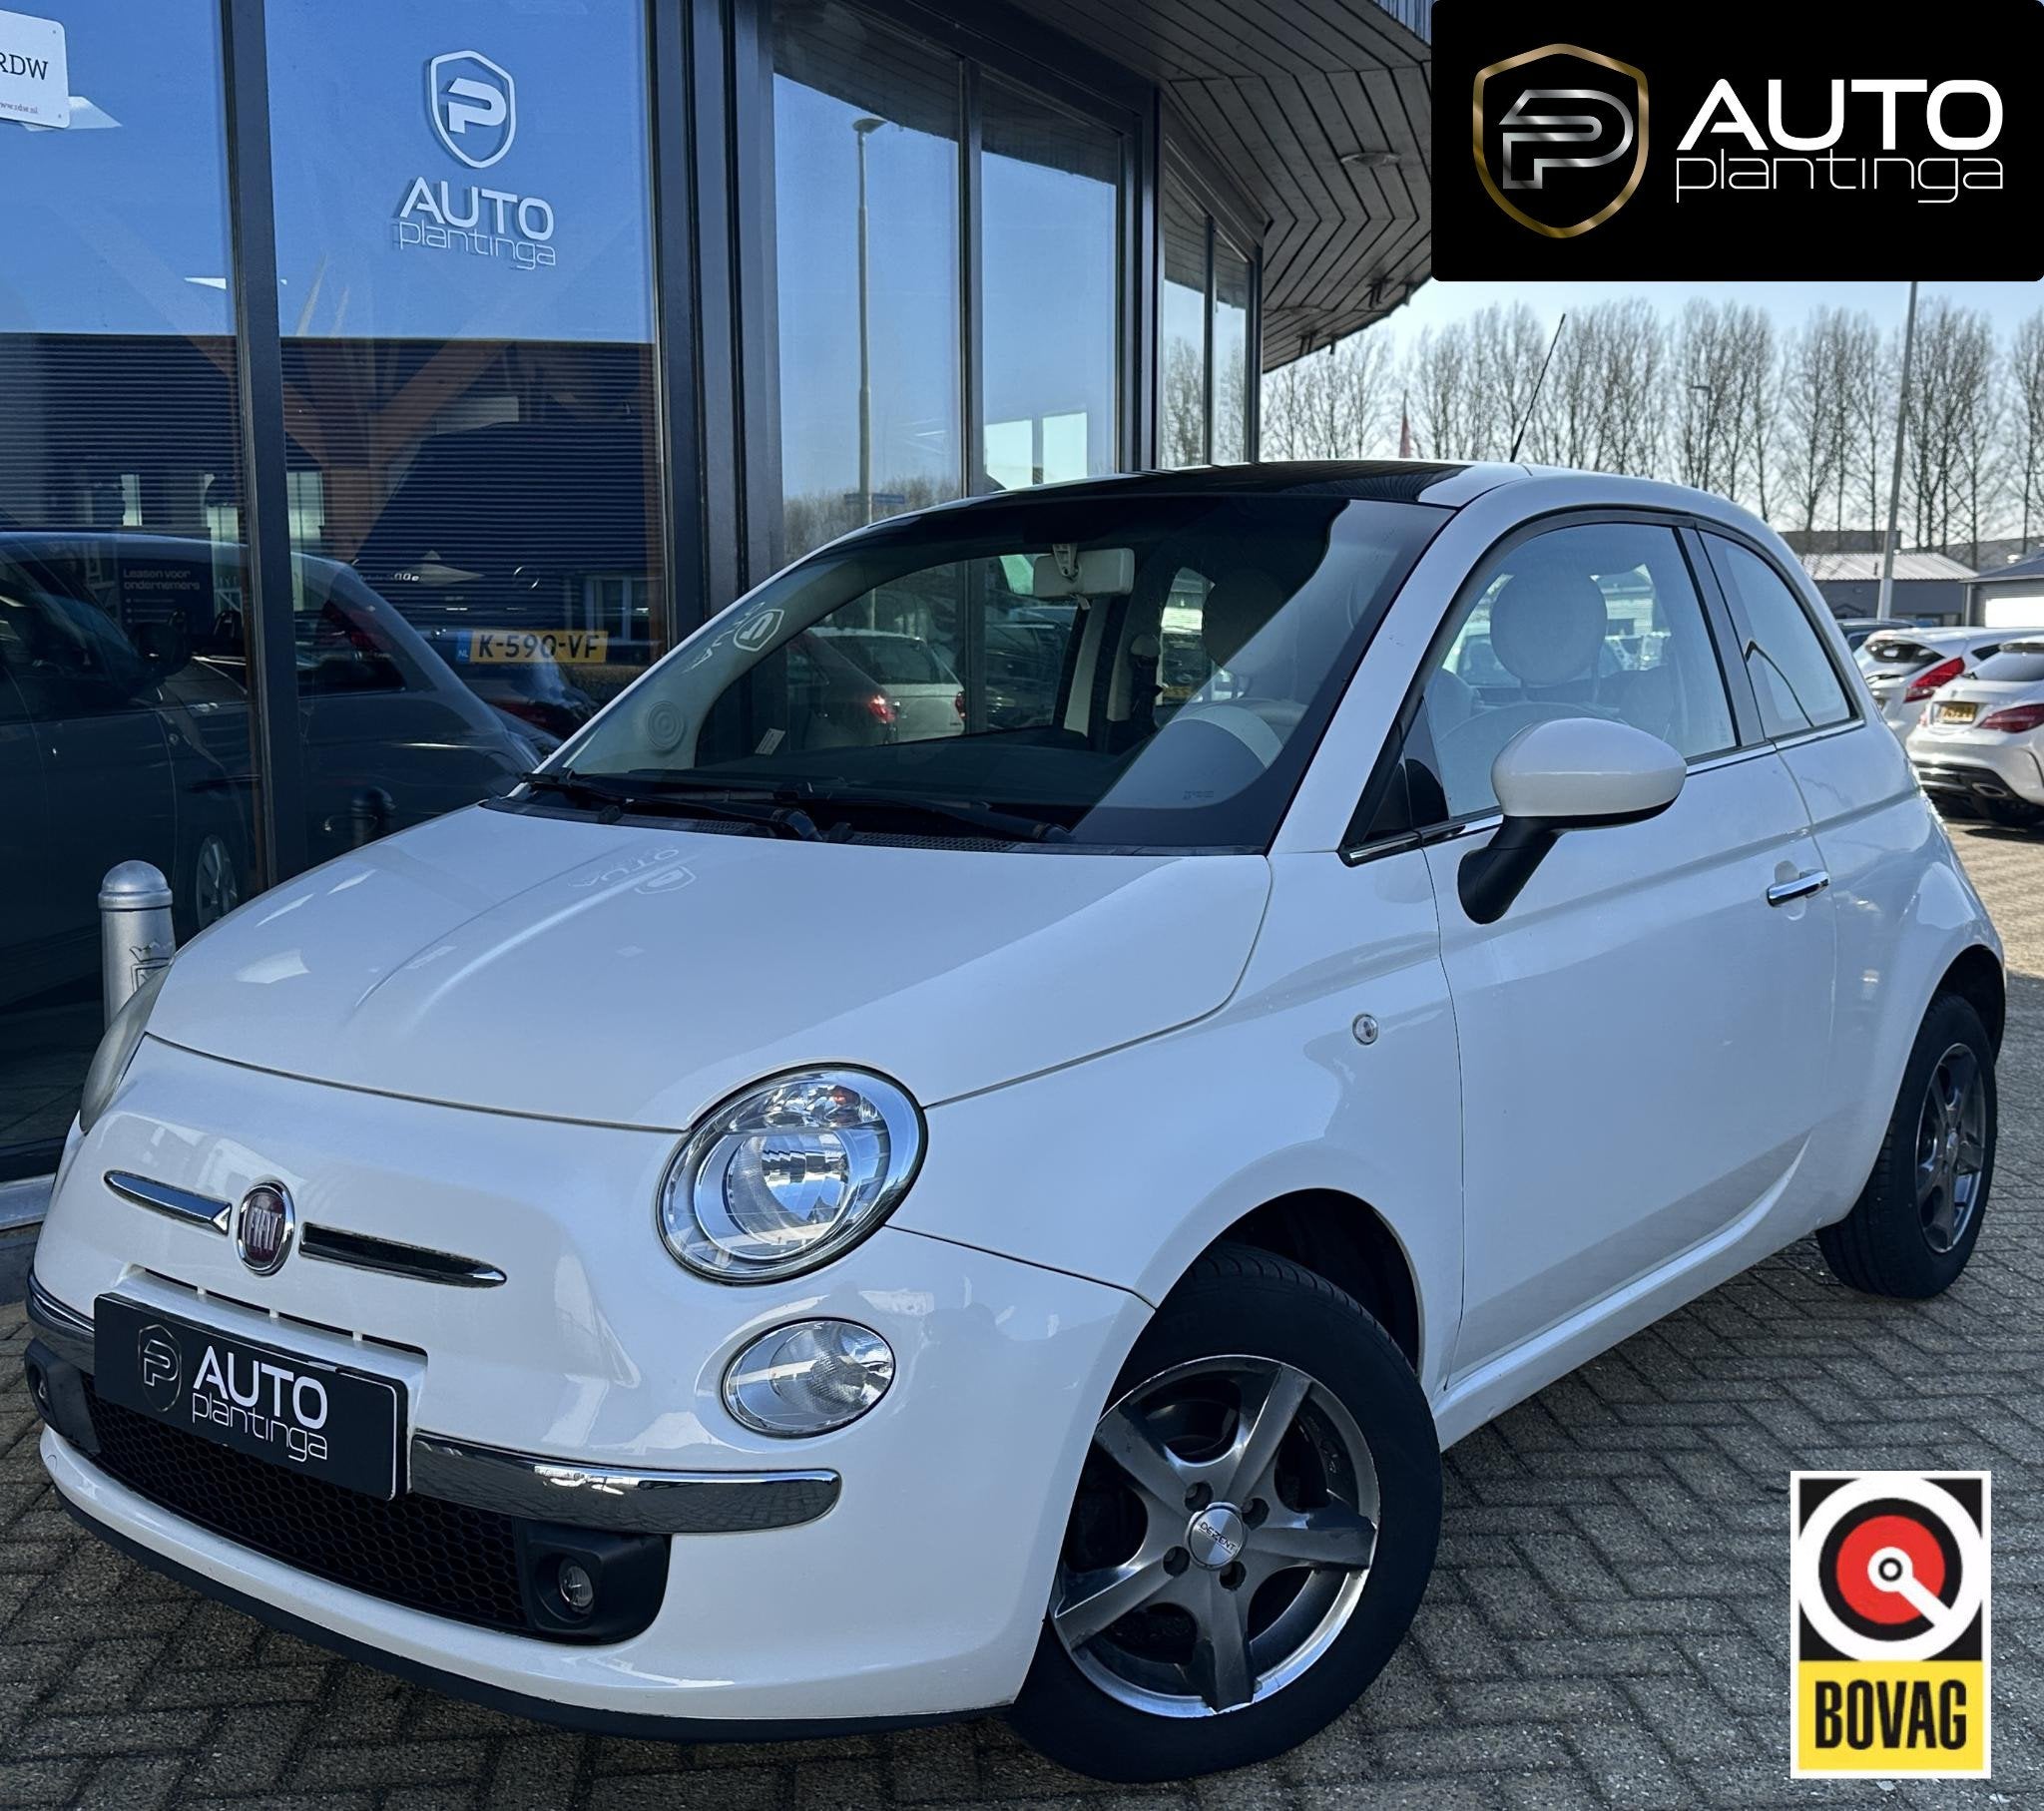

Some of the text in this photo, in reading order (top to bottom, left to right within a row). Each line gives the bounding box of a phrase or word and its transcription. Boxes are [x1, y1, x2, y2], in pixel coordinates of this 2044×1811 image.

[399, 176, 555, 241] AUTO
[399, 219, 556, 270] plantinga
[477, 634, 600, 659] K-590-VF
[247, 1205, 282, 1251] FIAT
[193, 1344, 328, 1430] AUTO
[192, 1391, 328, 1463] plantinga
[1199, 1521, 1237, 1552] DEZENT
